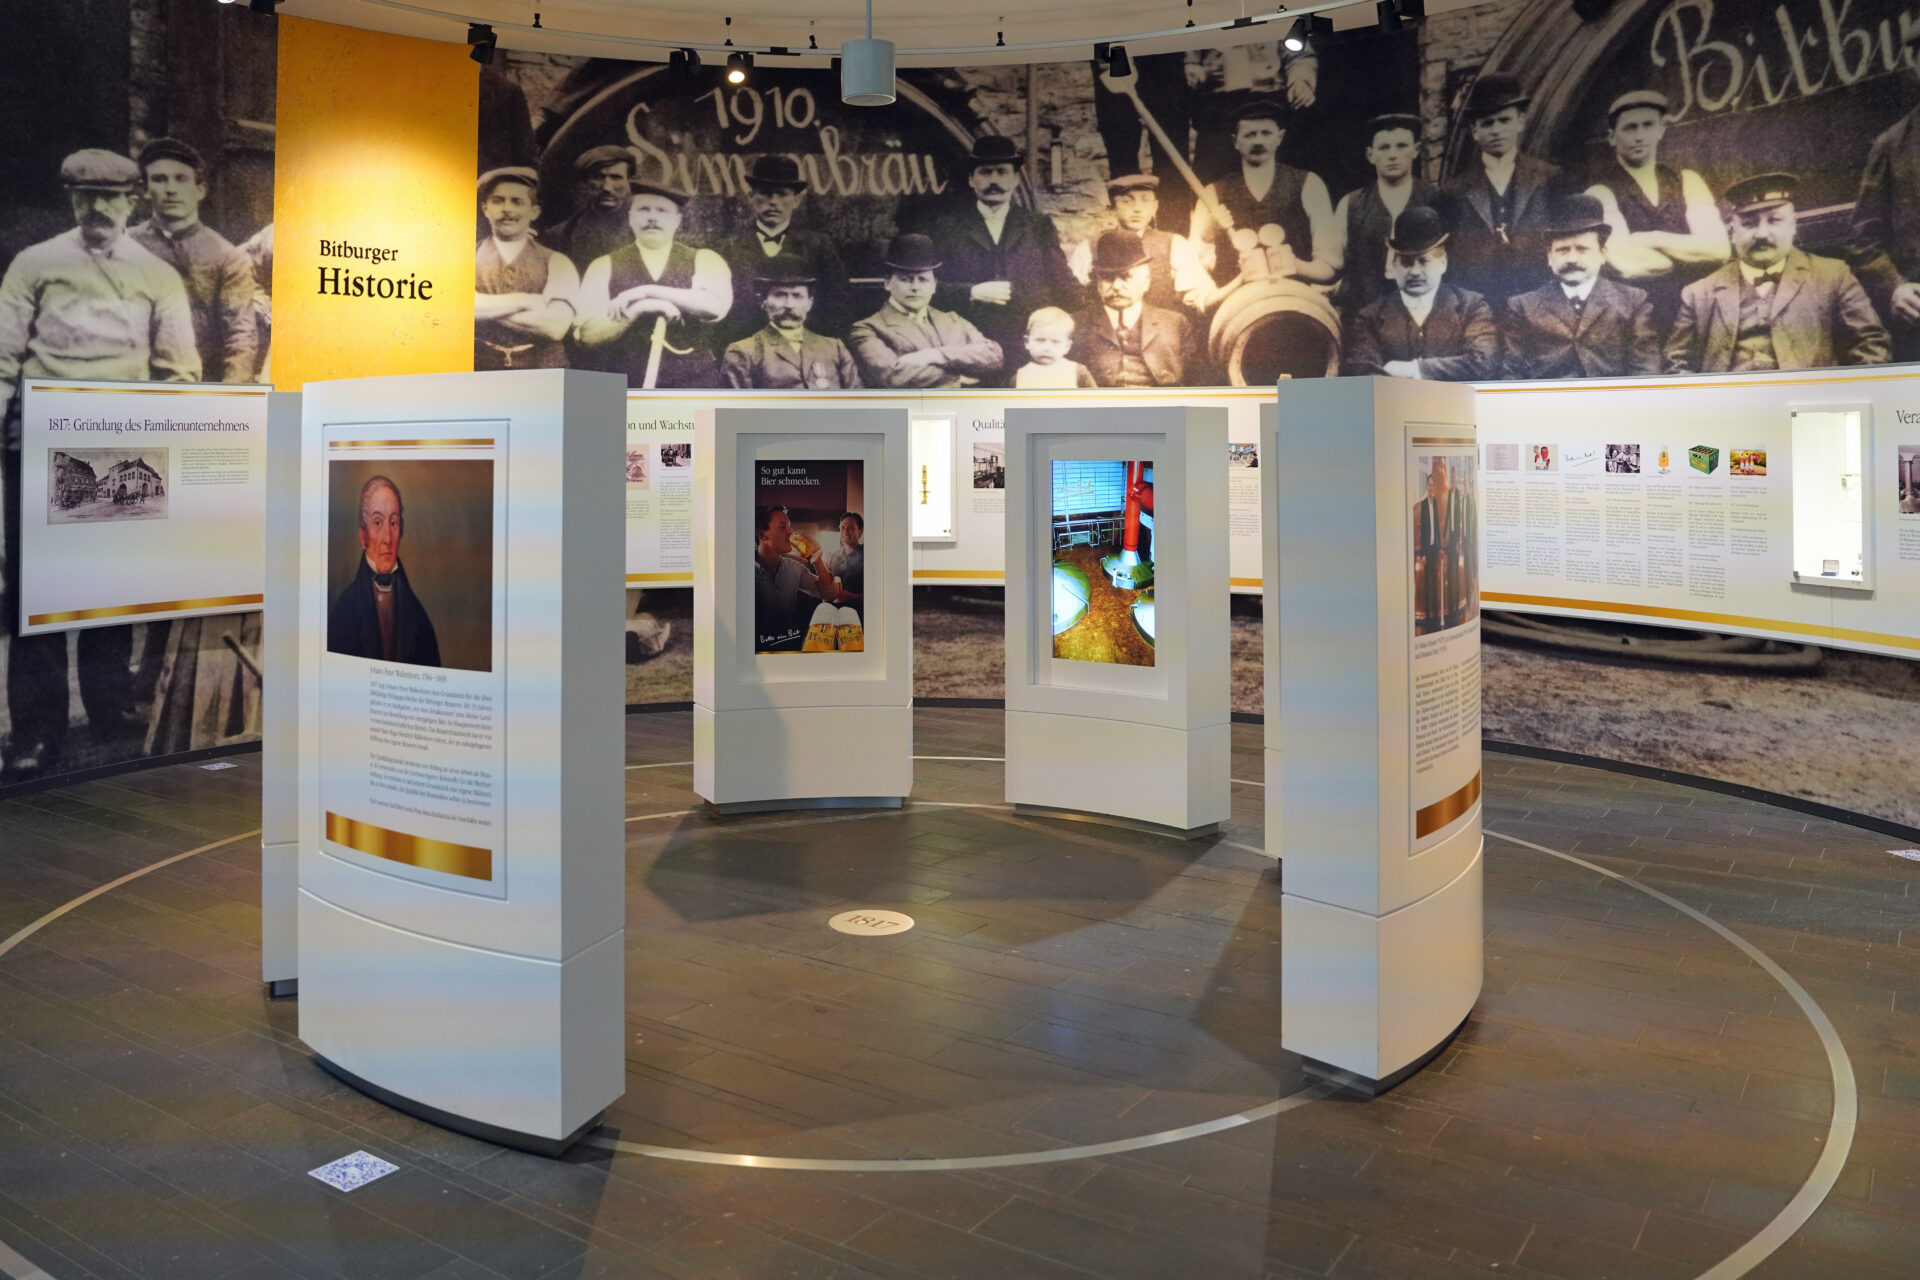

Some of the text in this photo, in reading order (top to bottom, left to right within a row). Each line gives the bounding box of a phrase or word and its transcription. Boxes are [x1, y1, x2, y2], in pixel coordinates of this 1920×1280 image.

[625, 102, 948, 197] Simnbräu
[319, 239, 398, 265] Bitburger
[317, 266, 433, 300] Historie
[48, 418, 250, 434] 1817: Gründung des Familienunternehmens
[639, 419, 657, 430] und
[760, 465, 806, 477] So gut kann
[761, 476, 776, 485] Bier
[846, 914, 901, 930] 1817
